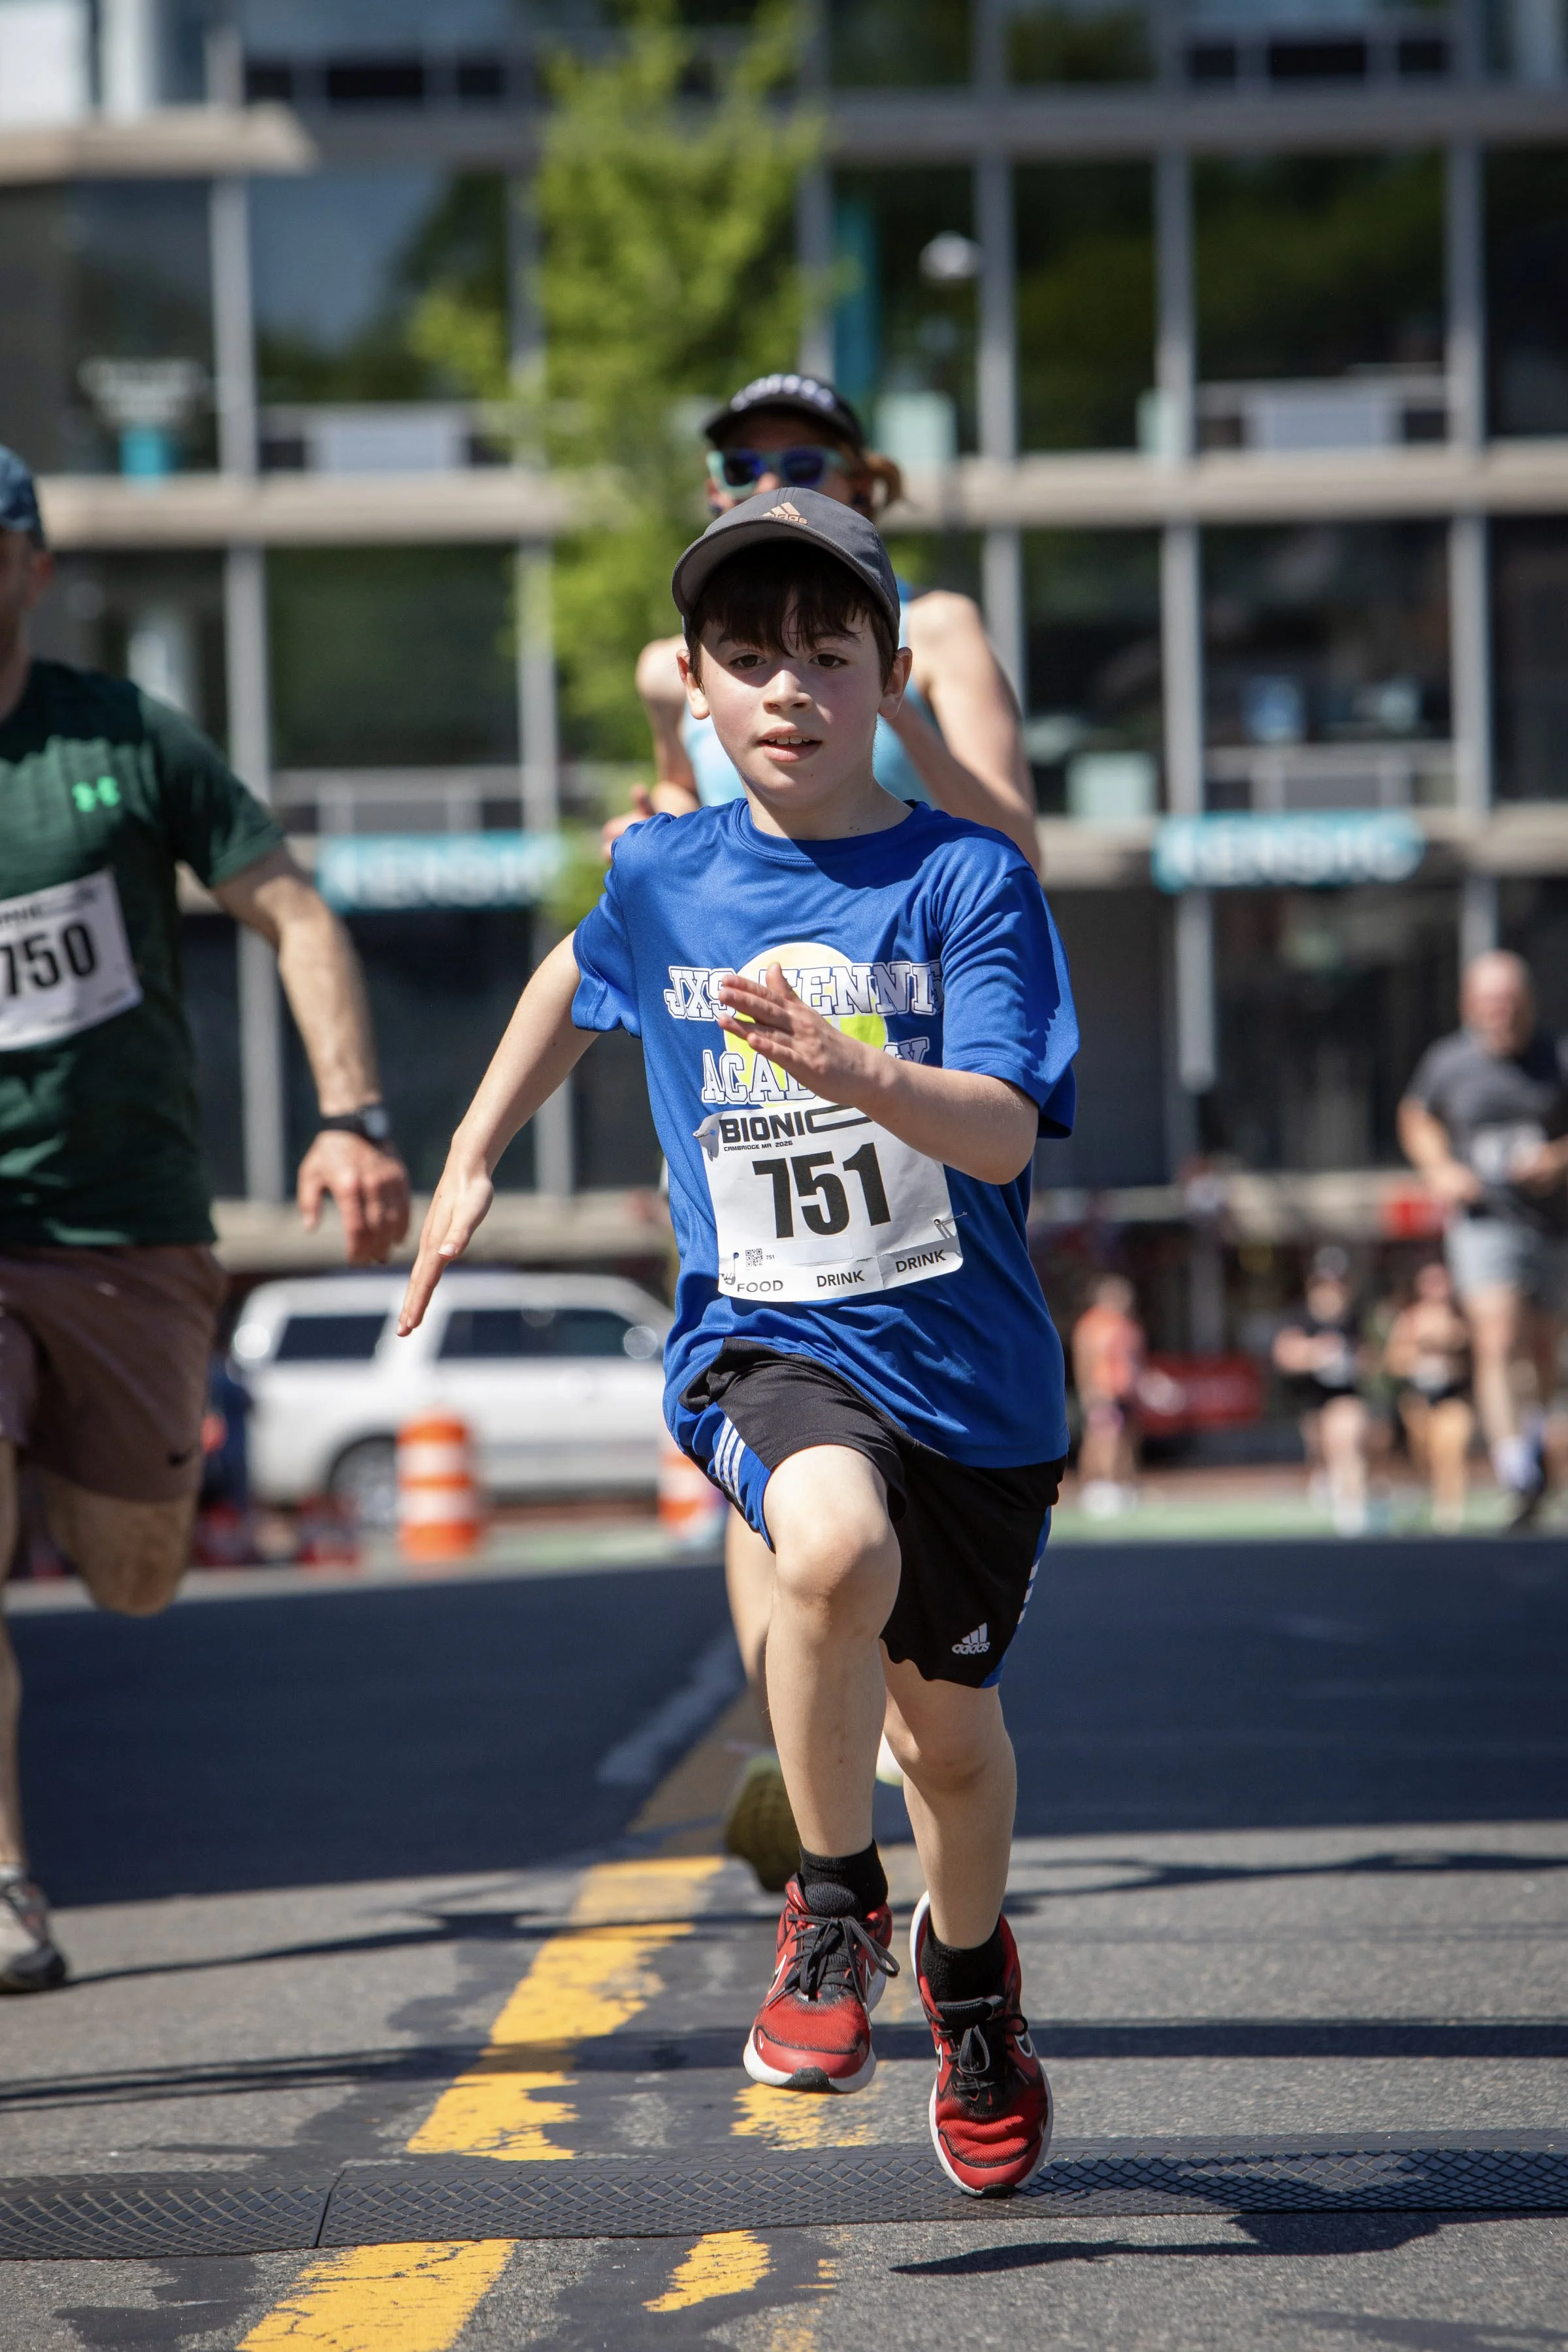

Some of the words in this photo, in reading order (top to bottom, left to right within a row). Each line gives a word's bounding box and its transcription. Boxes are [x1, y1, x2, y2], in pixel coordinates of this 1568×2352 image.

[0, 922, 95, 996] 750
[719, 1104, 874, 1143] BIONIC
[752, 1142, 892, 1239] 751
[737, 1280, 783, 1292] FOOD
[817, 1270, 865, 1288] DRINK
[895, 1249, 947, 1273] DRINK
[951, 1641, 991, 1655] adidas
